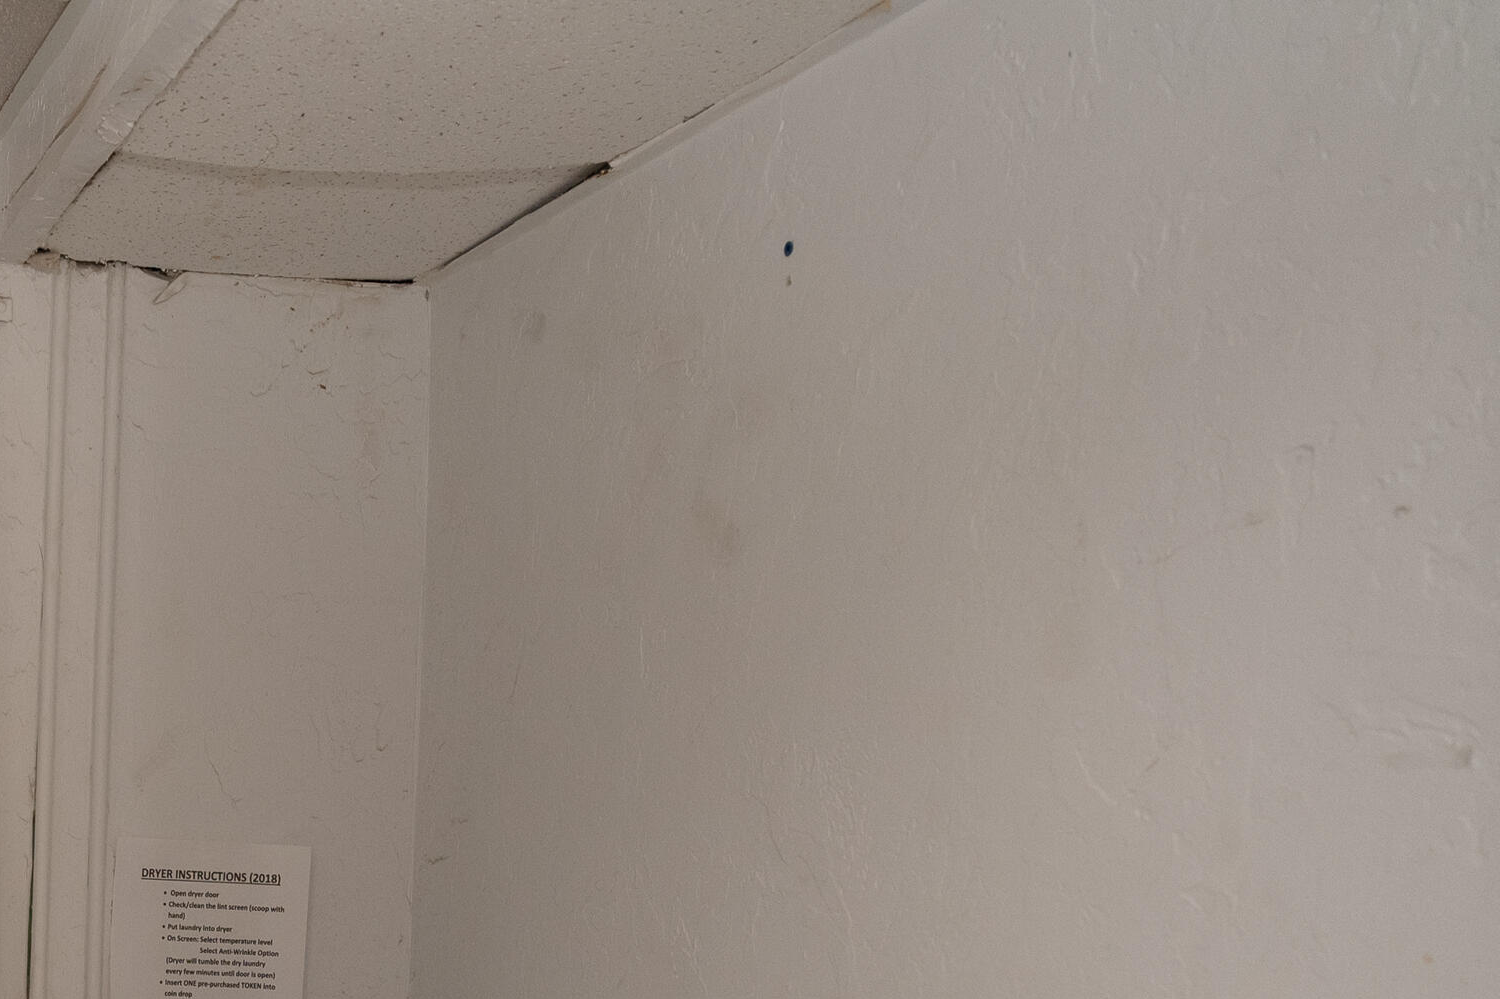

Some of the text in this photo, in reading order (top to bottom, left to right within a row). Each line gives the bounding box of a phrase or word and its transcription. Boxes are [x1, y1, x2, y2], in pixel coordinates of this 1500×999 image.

[141, 868, 281, 886] DRYER INSTRUCTIONS (2018)
[170, 889, 186, 897] Open
[168, 900, 204, 909] Check/clean
[248, 904, 269, 913] (scoop
[167, 911, 185, 920] hand)
[200, 935, 218, 943] Select
[218, 948, 256, 956] Anti-Wrinkle
[257, 949, 279, 957] Option
[165, 956, 184, 965] (Dryer
[198, 957, 219, 965] tumble
[231, 959, 241, 967] dry
[242, 959, 266, 968] laundry
[197, 980, 240, 989] pre-purchased
[262, 982, 276, 990] into
[178, 990, 192, 998] drop
